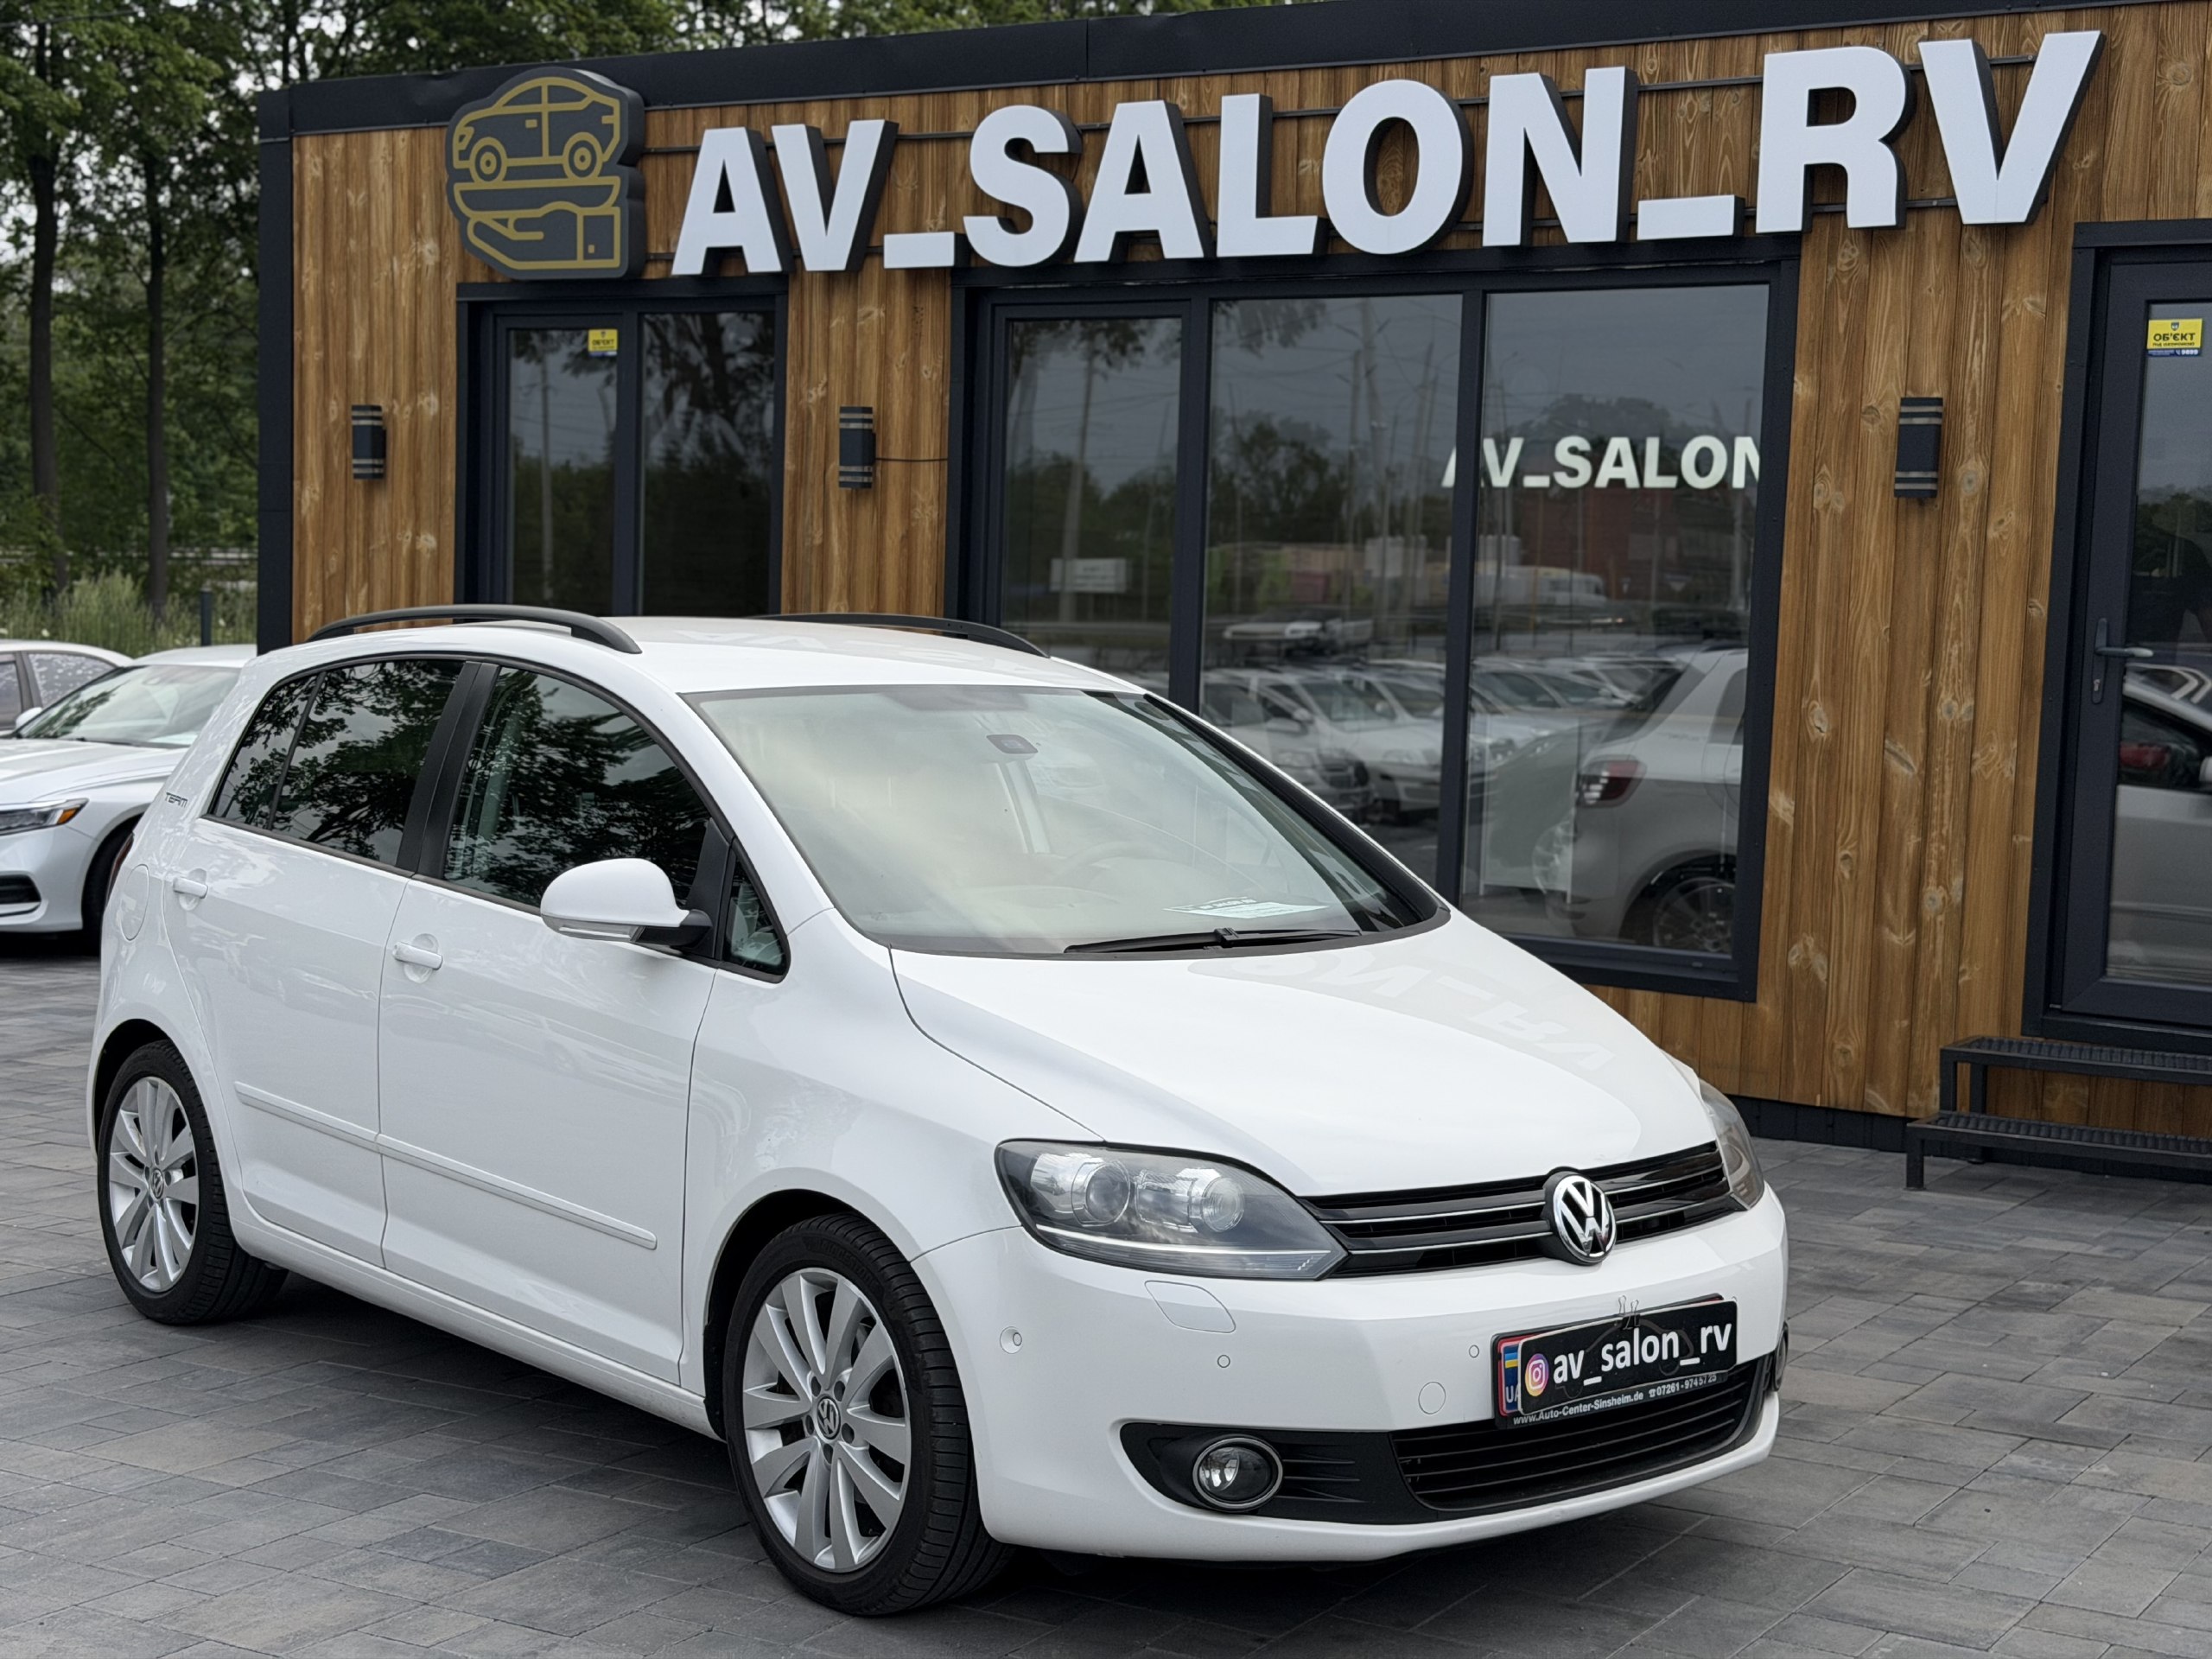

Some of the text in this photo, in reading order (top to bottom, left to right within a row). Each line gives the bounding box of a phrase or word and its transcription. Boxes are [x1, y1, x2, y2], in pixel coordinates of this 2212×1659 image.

[671, 30, 2104, 276] AV_SALON_RV
[1554, 1323, 1732, 1386] av_salon_rv
[1513, 1391, 1644, 1425] www.Auto-Center-Sinsheim.de
